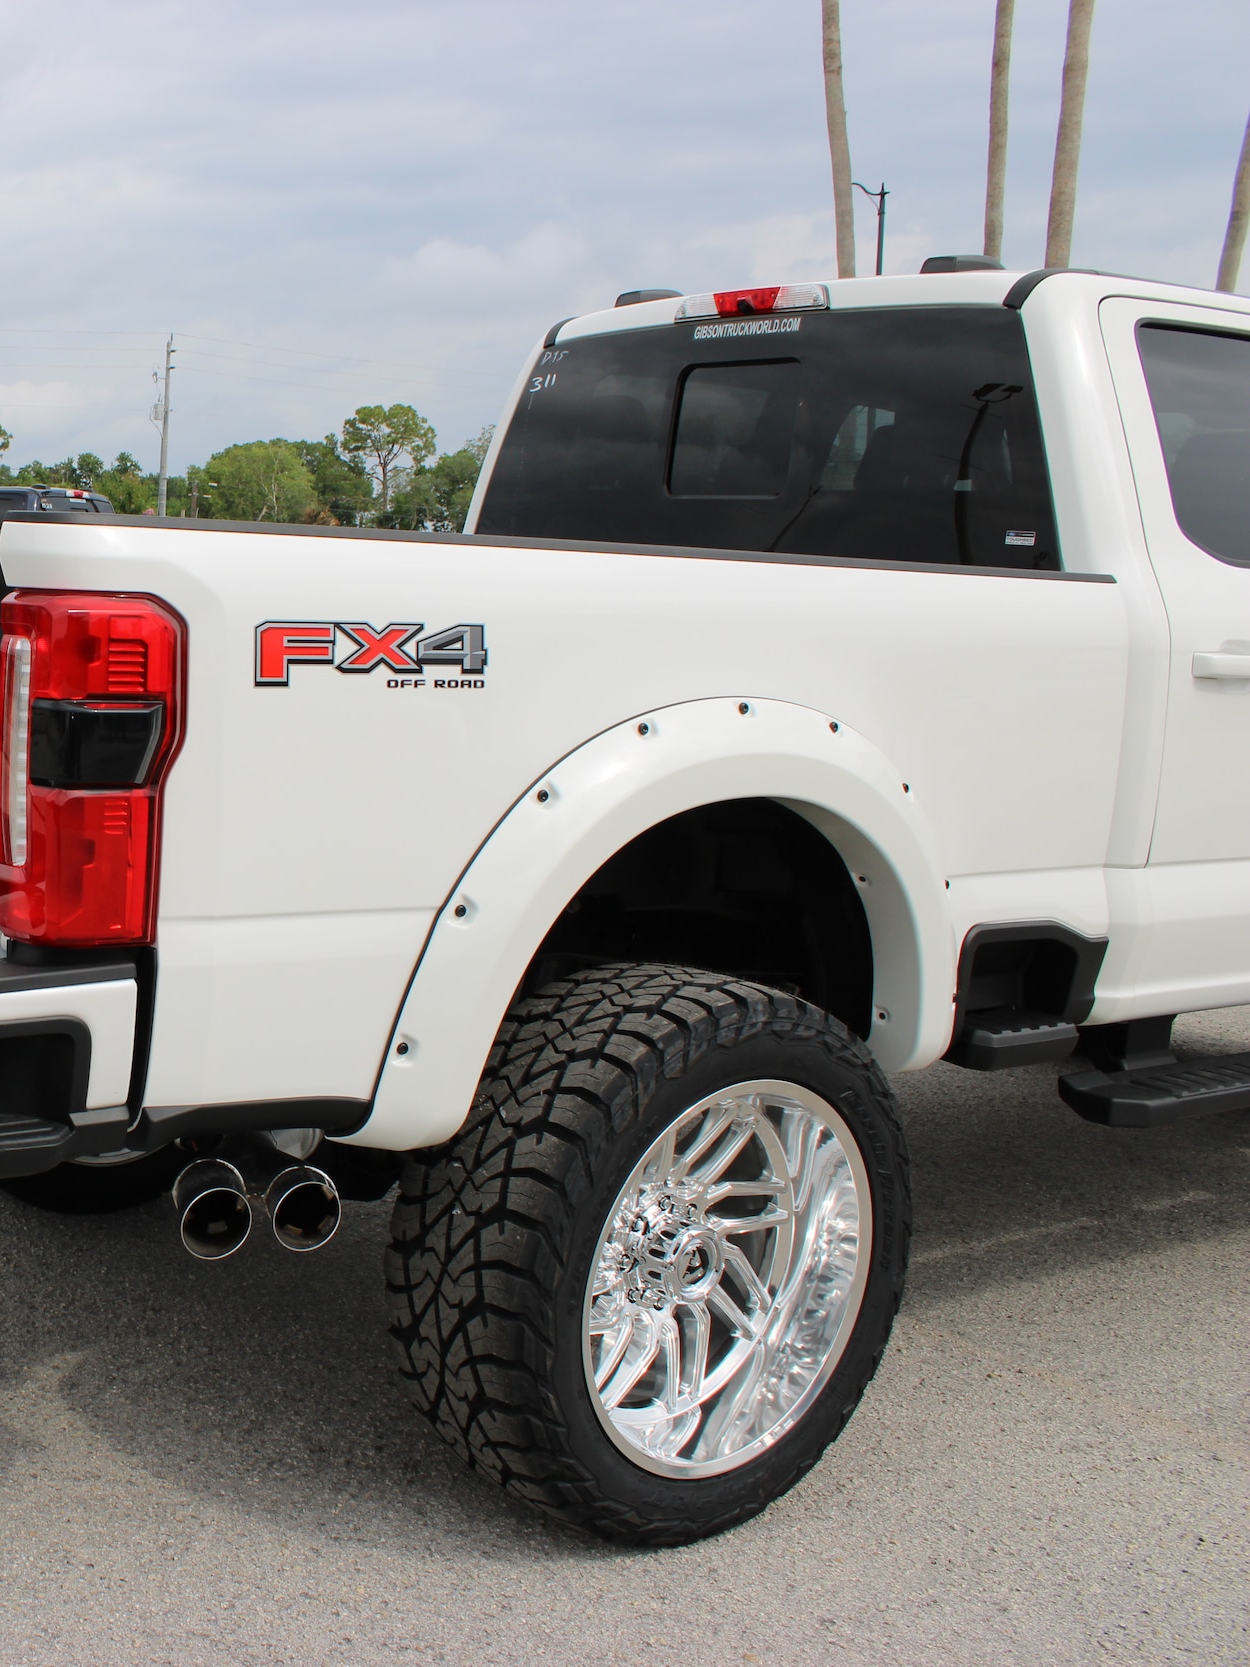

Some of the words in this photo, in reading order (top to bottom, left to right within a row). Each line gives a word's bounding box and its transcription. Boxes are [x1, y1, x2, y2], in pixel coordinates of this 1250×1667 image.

[694, 317, 801, 339] GIBSONTRUCKWORLD.COM
[529, 374, 557, 393] 311
[254, 620, 488, 688] FX4
[386, 679, 426, 689] OFF
[433, 679, 486, 689] ROAD
